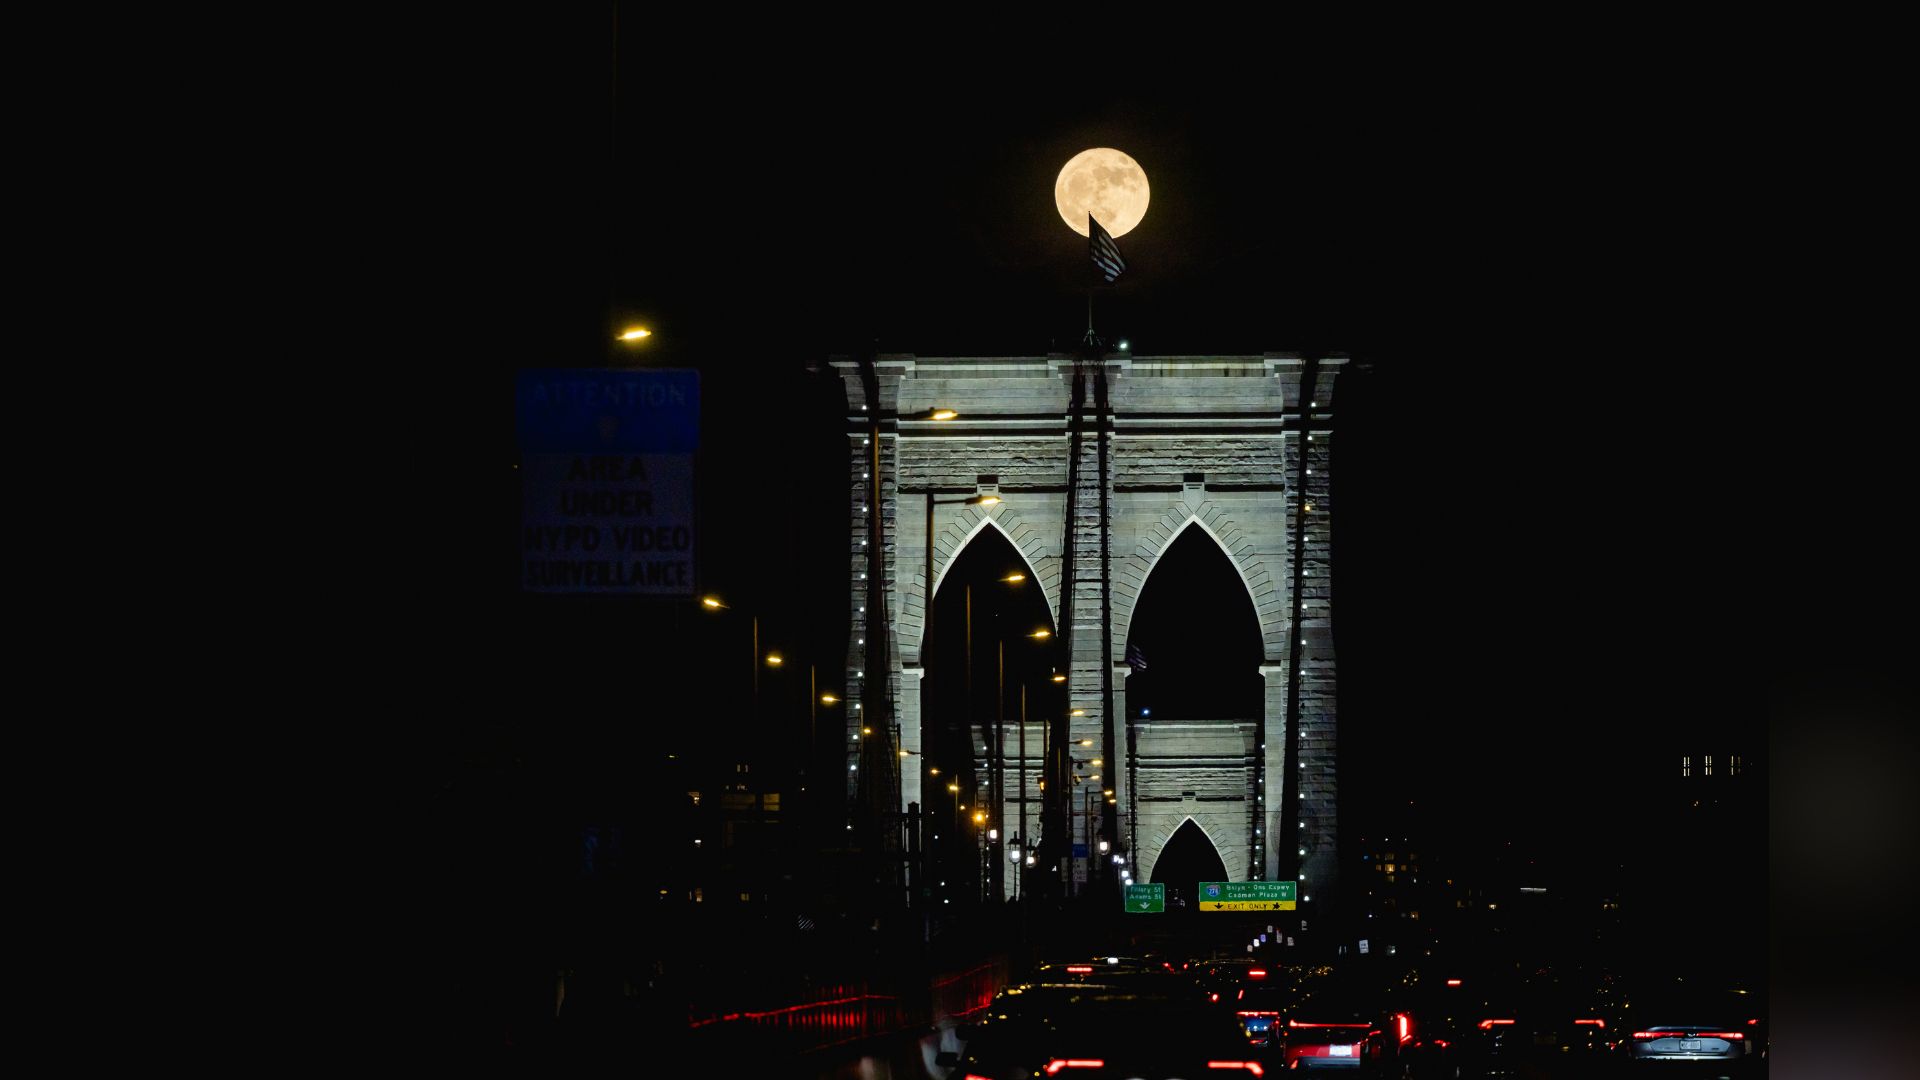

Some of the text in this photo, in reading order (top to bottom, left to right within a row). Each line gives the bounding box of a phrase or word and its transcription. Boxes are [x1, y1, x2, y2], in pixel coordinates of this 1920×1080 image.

[526, 381, 687, 408] ATTENTION
[568, 458, 647, 481] AREA
[560, 490, 653, 516] UNDER
[525, 526, 690, 551] NYPD VIDEO
[526, 560, 688, 586] SURVEILLANCE
